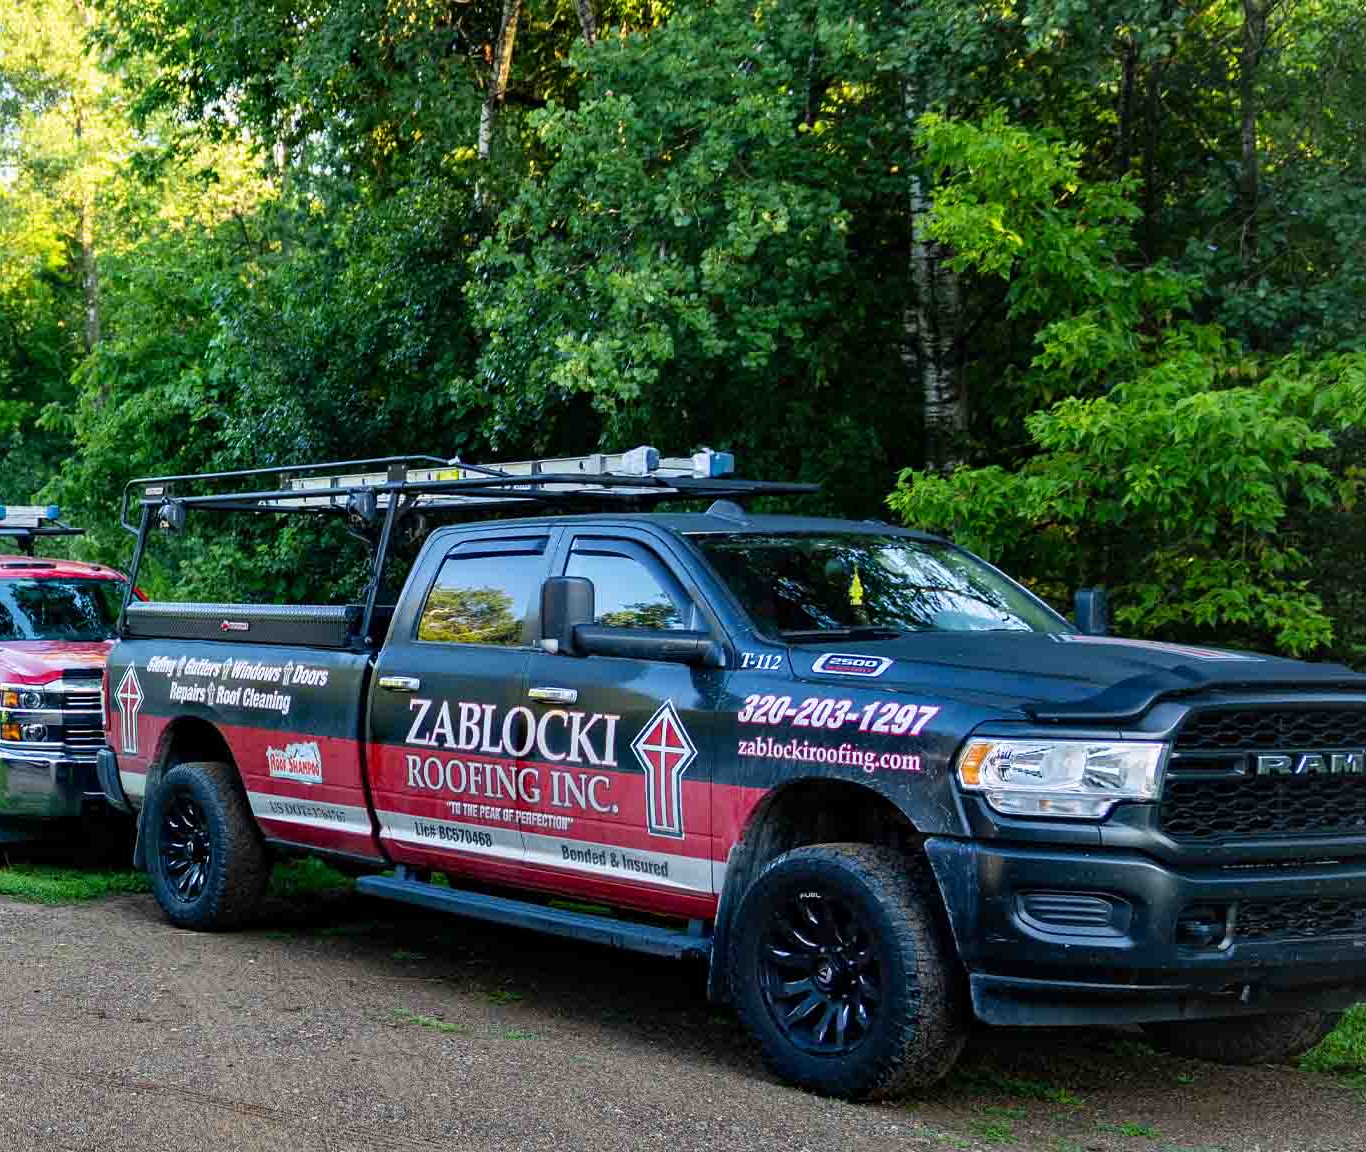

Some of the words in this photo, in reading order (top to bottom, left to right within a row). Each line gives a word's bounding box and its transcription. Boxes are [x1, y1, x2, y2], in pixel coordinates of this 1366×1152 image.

[147, 656, 176, 677] Siding
[184, 657, 222, 678] Gutters
[231, 658, 282, 683] Windows
[292, 664, 330, 687] Doors
[741, 652, 783, 671] T-112
[828, 656, 878, 668] 2500
[170, 681, 207, 704] Repairs
[216, 685, 242, 706] Roof
[242, 687, 292, 715] Cleaning
[737, 693, 939, 737] 320-203-1297
[405, 697, 621, 768] ZABLOCKI
[270, 753, 287, 772] ROOF
[288, 758, 320, 778] SHAMPOO
[738, 736, 922, 773] zablockiroofing.com
[1257, 752, 1363, 776] RAM
[405, 754, 540, 805] ROOFING
[551, 770, 620, 815] INC.
[462, 802, 478, 817] THE
[479, 804, 501, 820] PEAK
[502, 808, 515, 821] OF
[438, 825, 493, 848] BC570468
[561, 845, 606, 867] Bonded
[609, 852, 619, 868] &
[621, 854, 669, 877] Insured
